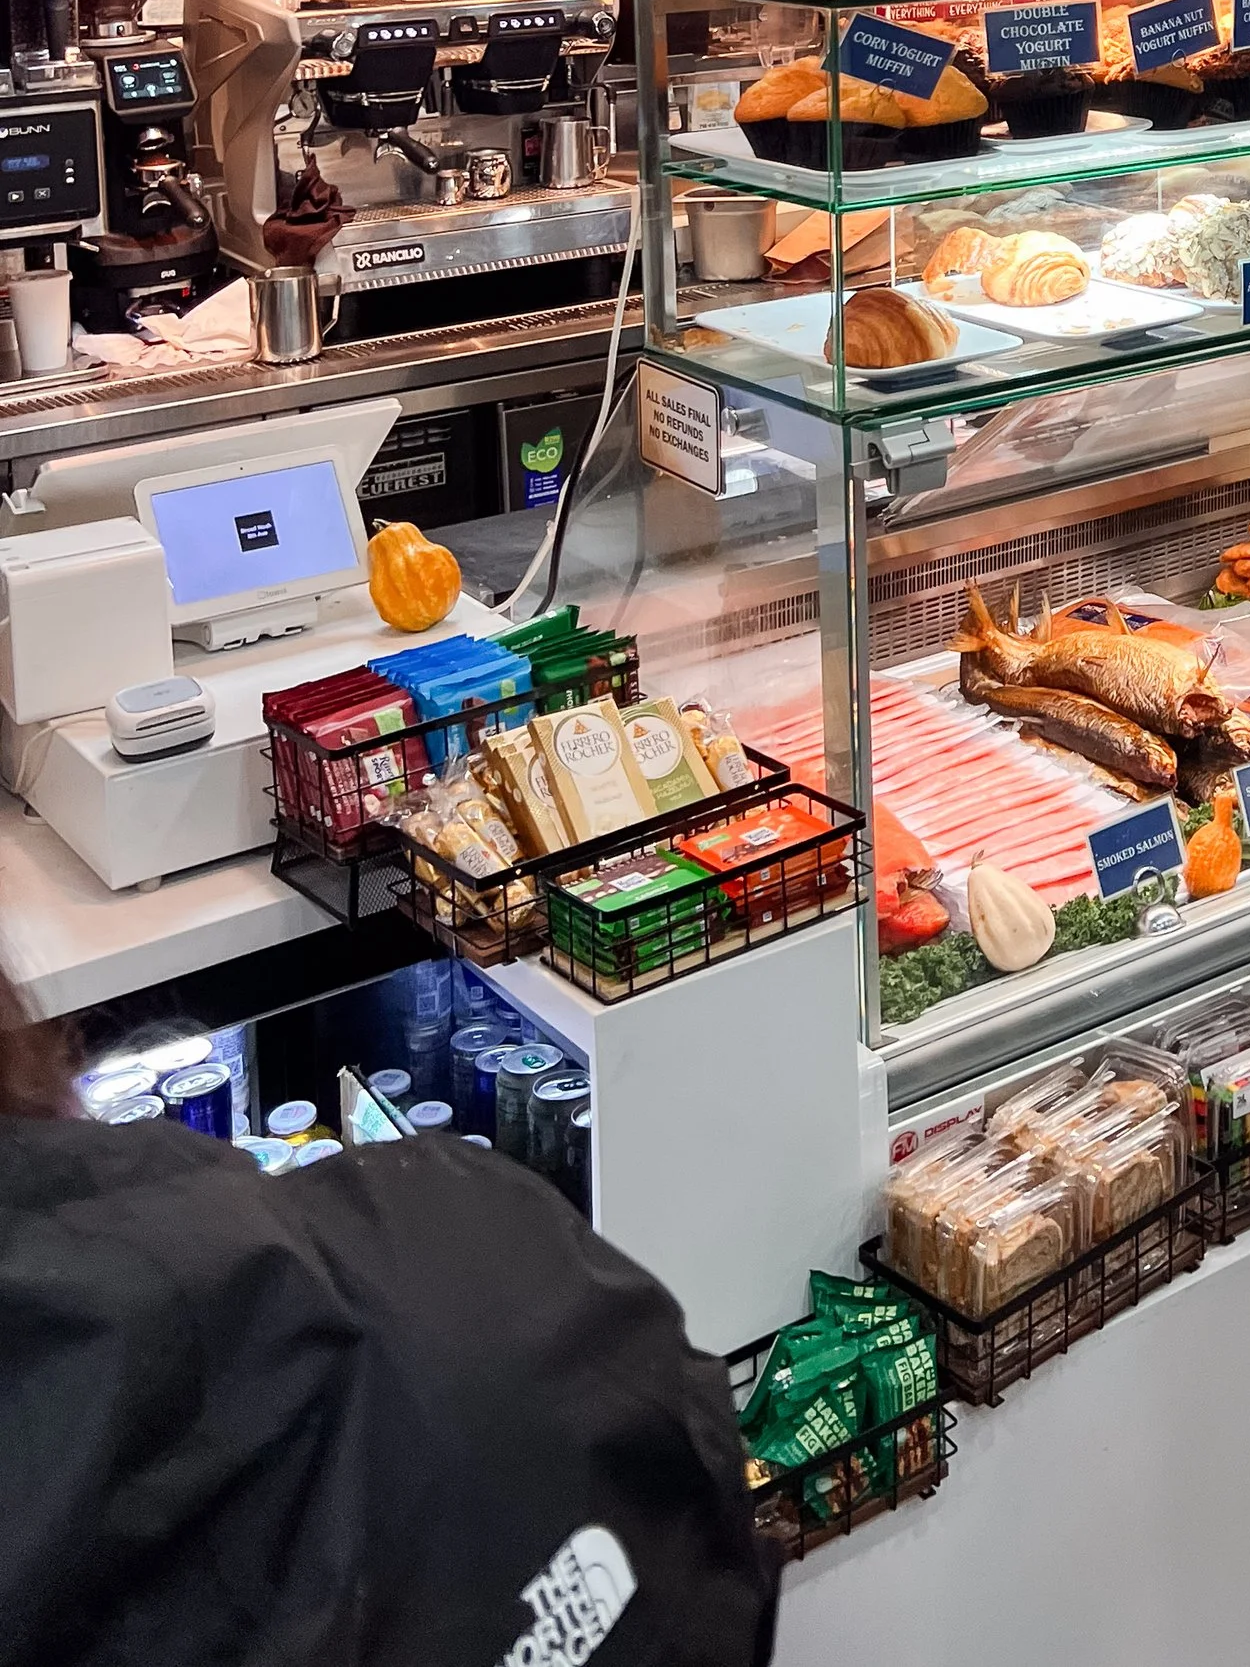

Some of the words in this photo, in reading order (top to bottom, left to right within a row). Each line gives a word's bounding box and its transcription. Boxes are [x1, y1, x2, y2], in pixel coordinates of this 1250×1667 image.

[1013, 5, 1070, 21] DOUBLE
[1140, 16, 1183, 38] BANANA
[1183, 8, 1204, 25] NUT
[1000, 19, 1085, 39] CHOCOLATE
[1135, 32, 1177, 55] YOGURT
[1178, 21, 1214, 41] MUFFIN
[853, 31, 890, 52] CORN
[891, 41, 943, 67] YOGURT
[1015, 38, 1072, 55] YOGURT
[865, 54, 914, 77] MUFFIN
[1019, 55, 1071, 71] MUFFIN
[9, 124, 51, 136] BUNN
[372, 247, 423, 265] RANCILIO
[646, 389, 660, 404] ALL
[661, 395, 686, 416] SALES
[688, 407, 711, 428] FINAL
[653, 409, 665, 424] NO
[666, 415, 704, 442] REFUNDS
[526, 446, 558, 463] ECO
[649, 424, 660, 440] NO
[662, 431, 710, 463] EXCHANGES
[560, 730, 611, 753] FERRERO
[564, 742, 616, 764] ROCHER
[1096, 846, 1136, 871] SMOKED
[1135, 829, 1174, 855] SALMON
[924, 1105, 983, 1139] DISPLAY
[898, 1361, 912, 1382] FIG
[800, 1428, 818, 1450] FIG
